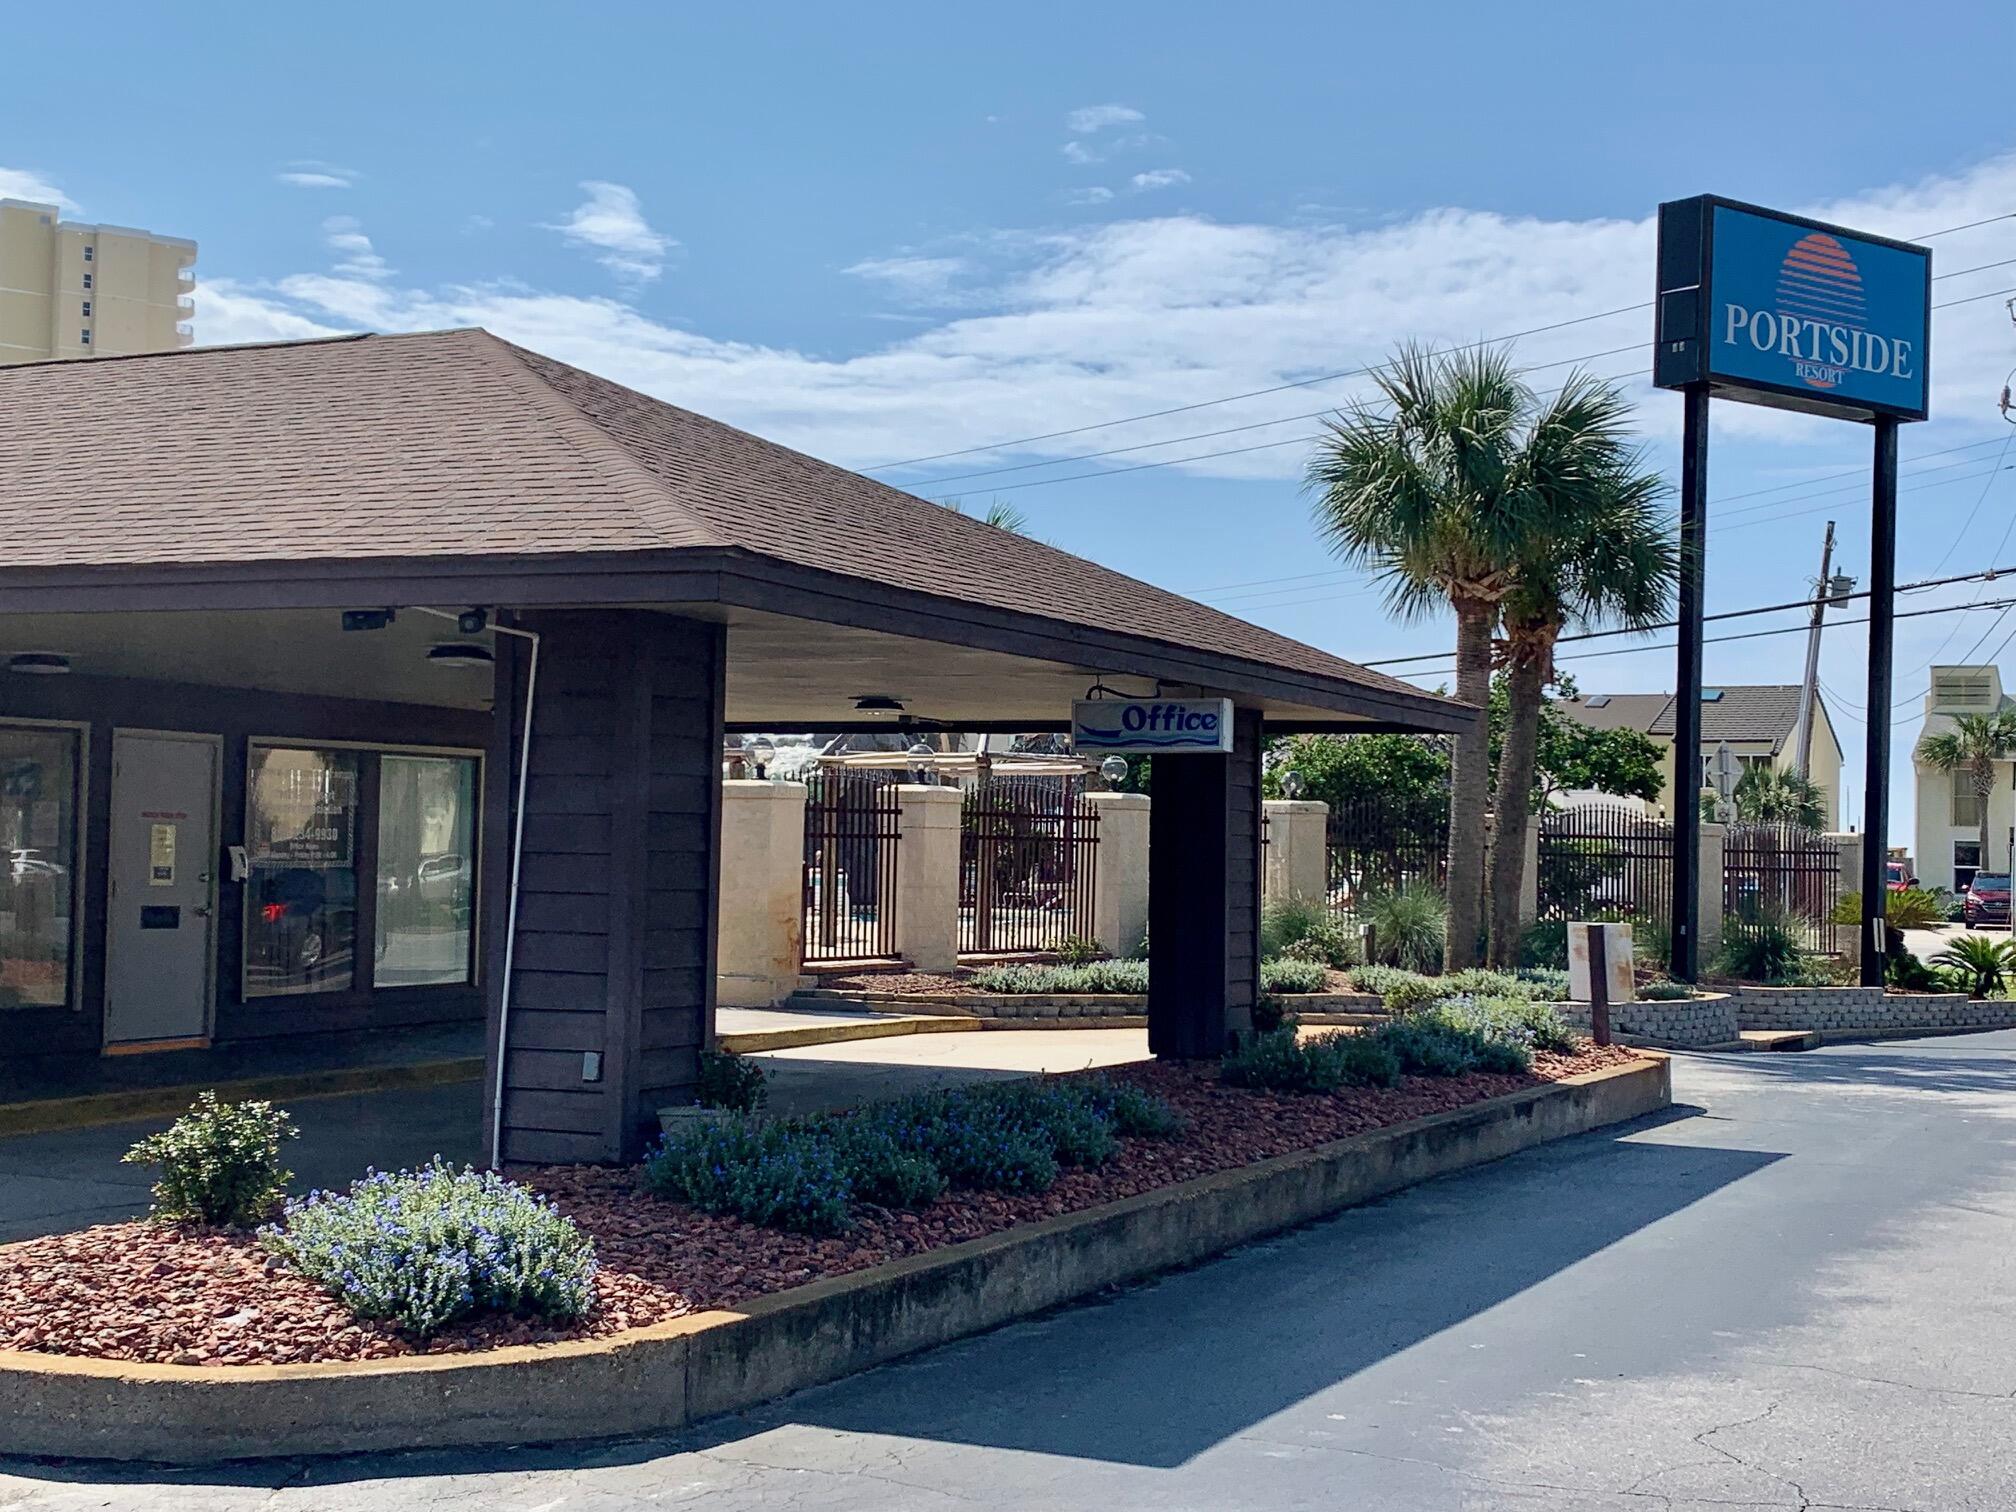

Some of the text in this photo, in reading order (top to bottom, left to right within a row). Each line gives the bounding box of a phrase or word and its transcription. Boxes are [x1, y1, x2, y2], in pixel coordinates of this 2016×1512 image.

[1724, 303, 1913, 379] PORTSIDE
[1795, 362, 1842, 384] RESORT
[1122, 704, 1218, 731] Office
